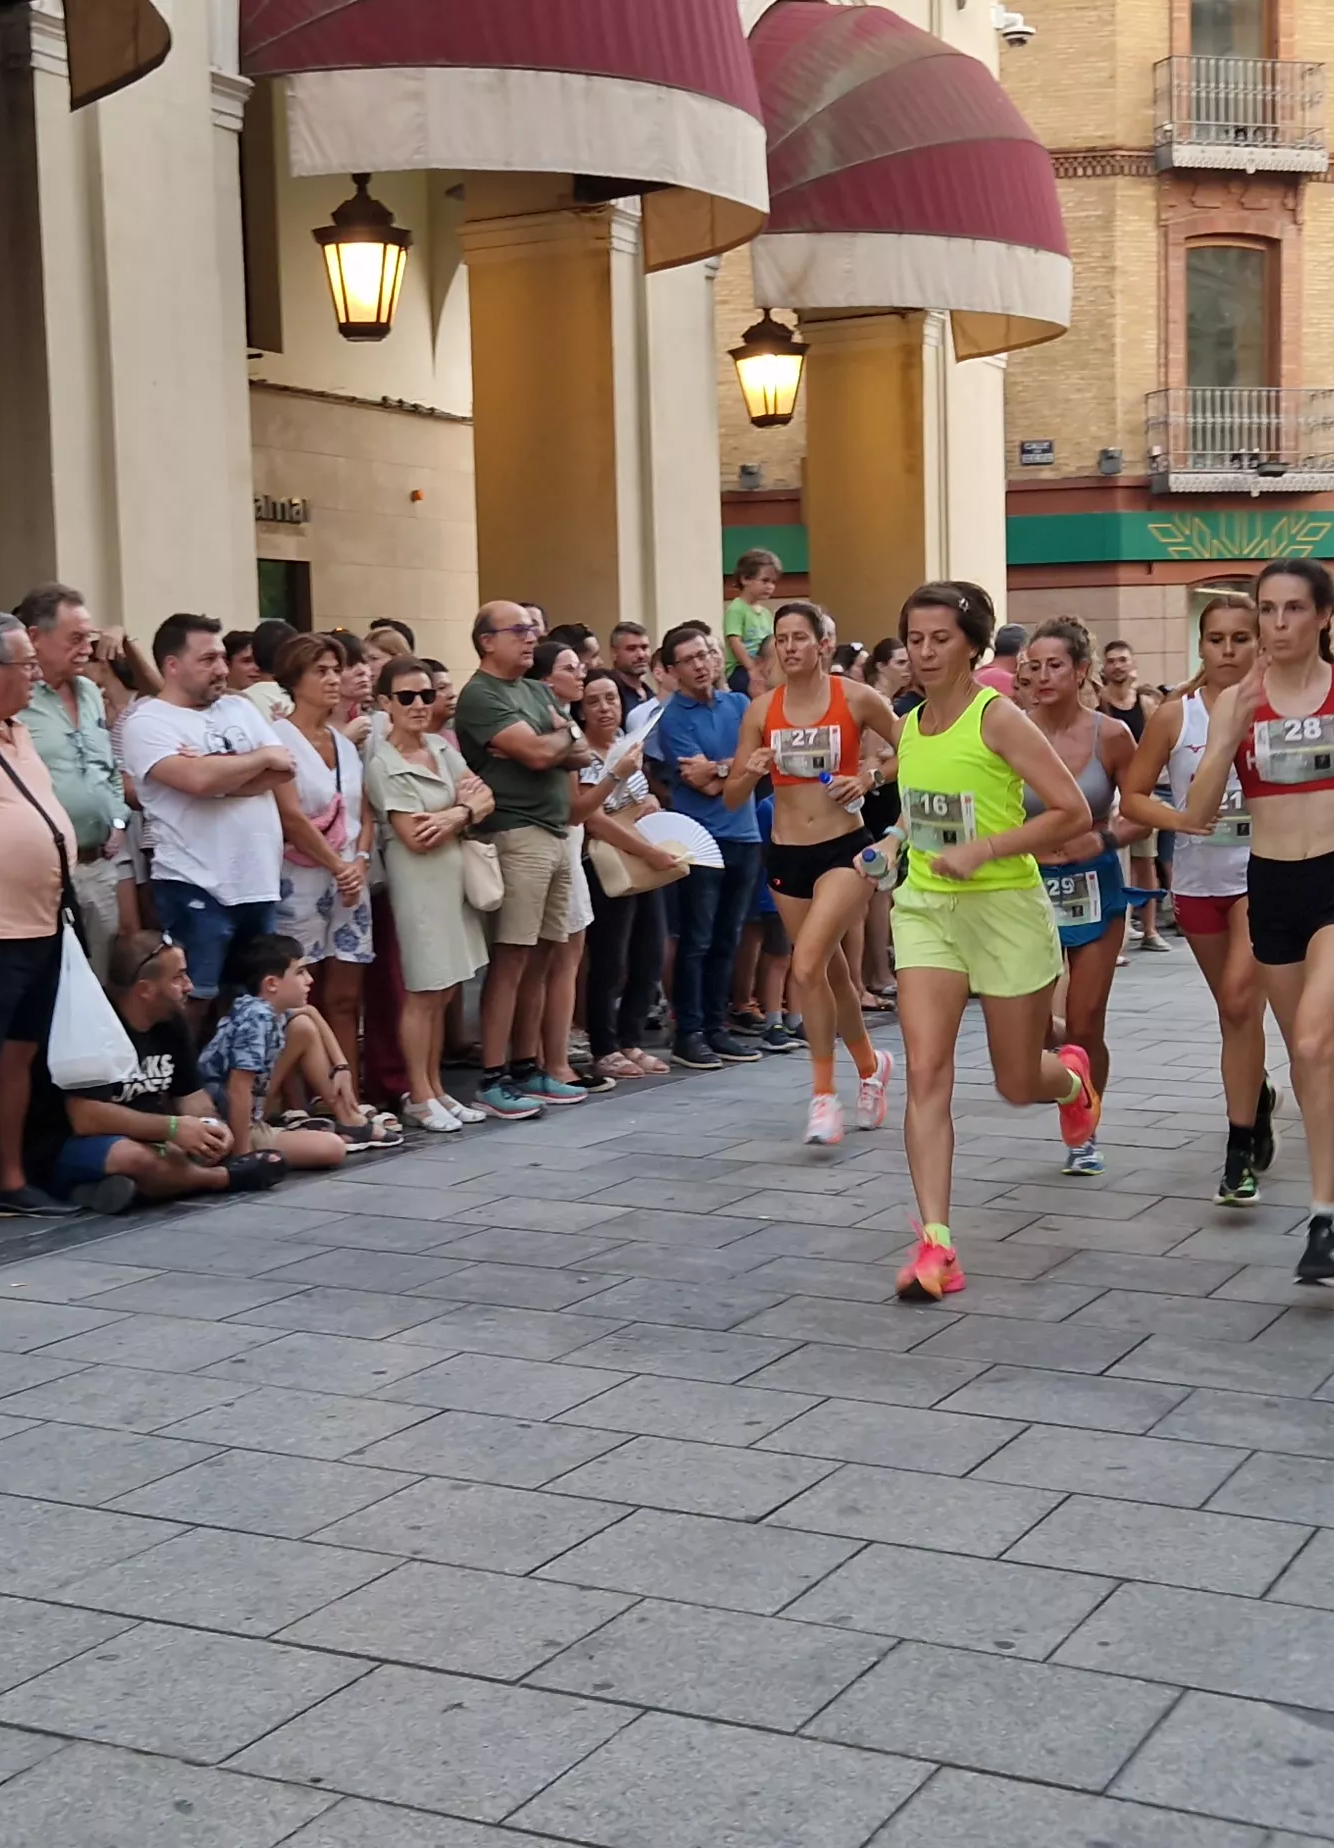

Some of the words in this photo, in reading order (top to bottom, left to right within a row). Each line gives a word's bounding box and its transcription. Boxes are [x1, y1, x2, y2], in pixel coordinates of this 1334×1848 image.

[791, 728, 818, 747] 27
[1283, 717, 1322, 741] 28
[920, 792, 948, 816] 16
[1047, 877, 1075, 896] 29
